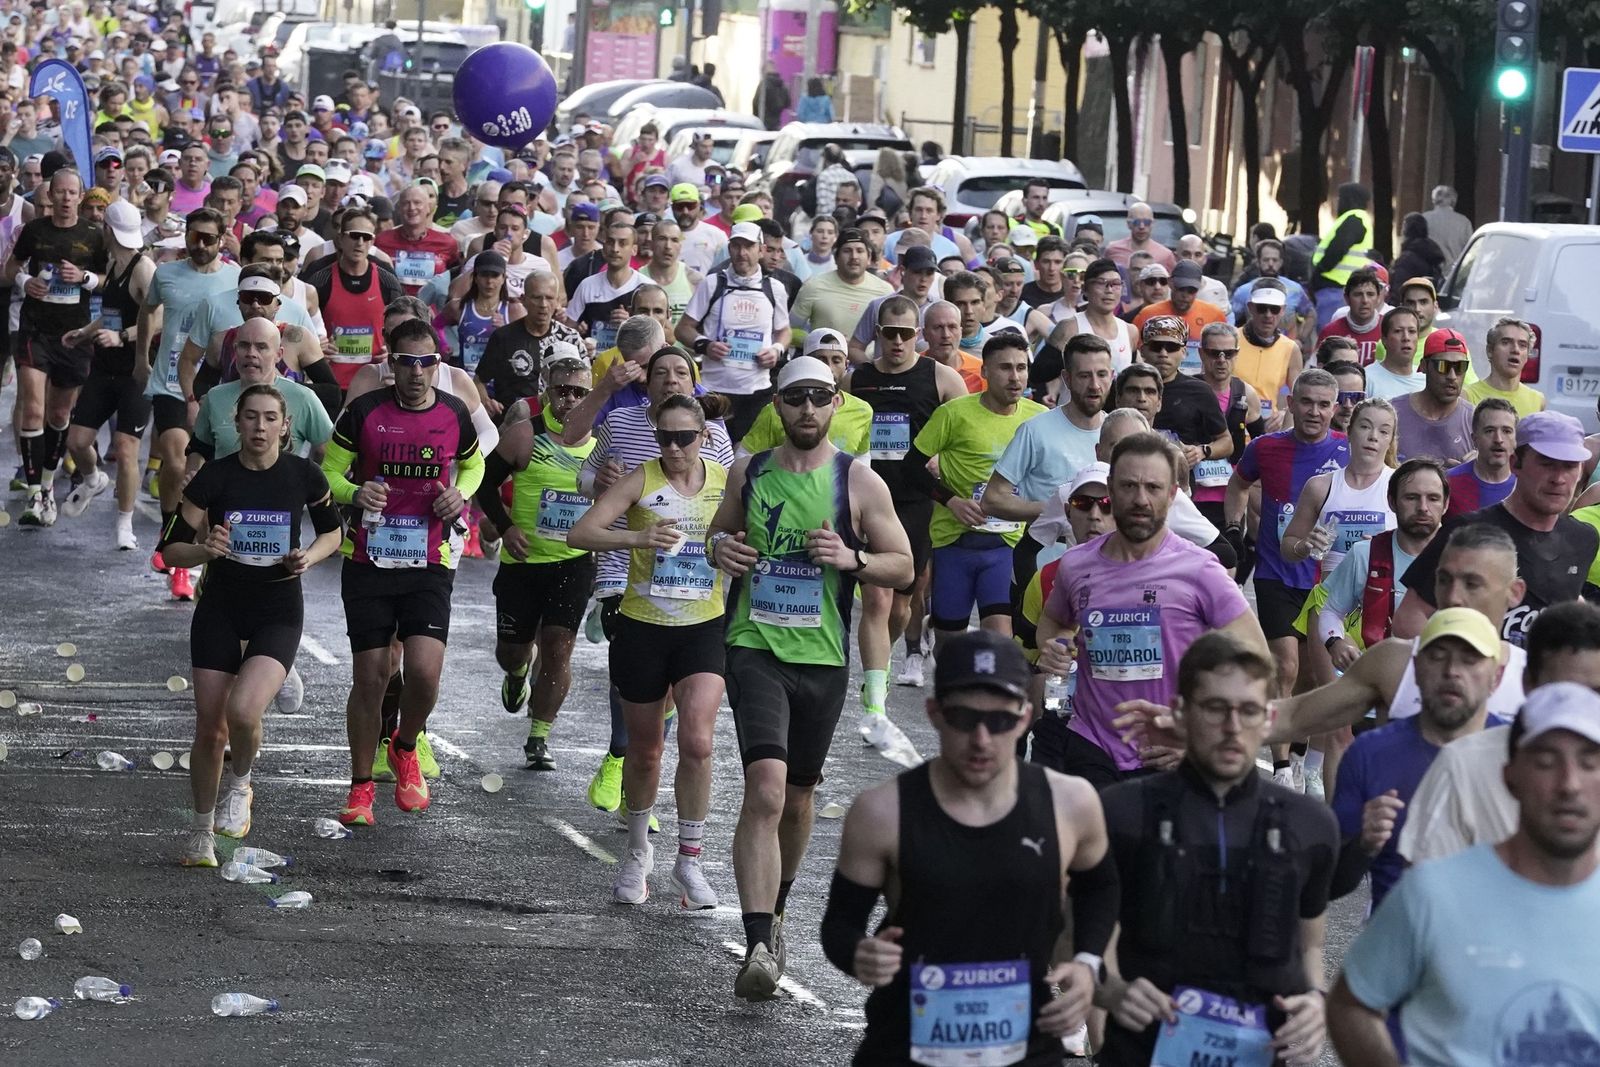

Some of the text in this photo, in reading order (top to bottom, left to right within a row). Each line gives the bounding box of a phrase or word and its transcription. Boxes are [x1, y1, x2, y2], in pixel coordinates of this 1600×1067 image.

[497, 106, 532, 136] 3:30
[404, 269, 425, 277] DAVID
[1565, 378, 1599, 391] 9177
[383, 464, 440, 477] RUNNER
[1199, 467, 1229, 477] DANIEL
[560, 494, 589, 503] ZURICH
[246, 514, 283, 522] ZURICH
[1344, 514, 1378, 522] ZURICH
[247, 530, 267, 538] 6253
[1345, 530, 1363, 538] 7127
[233, 541, 280, 553] MARRIS
[368, 546, 426, 558] FER SANABRIA
[681, 546, 706, 554] ZURIC
[677, 561, 697, 570] 7967
[775, 565, 815, 576] ZURICH
[653, 576, 713, 587] CARMEN PEREA
[775, 585, 796, 594] 9470
[751, 600, 820, 613] LUISVI Y RAQUEL
[1108, 612, 1150, 622] ZURICH
[1088, 648, 1162, 663] EDU/CAROL
[951, 967, 1017, 985] ZURICH
[930, 1018, 1012, 1042] ÁLVARO
